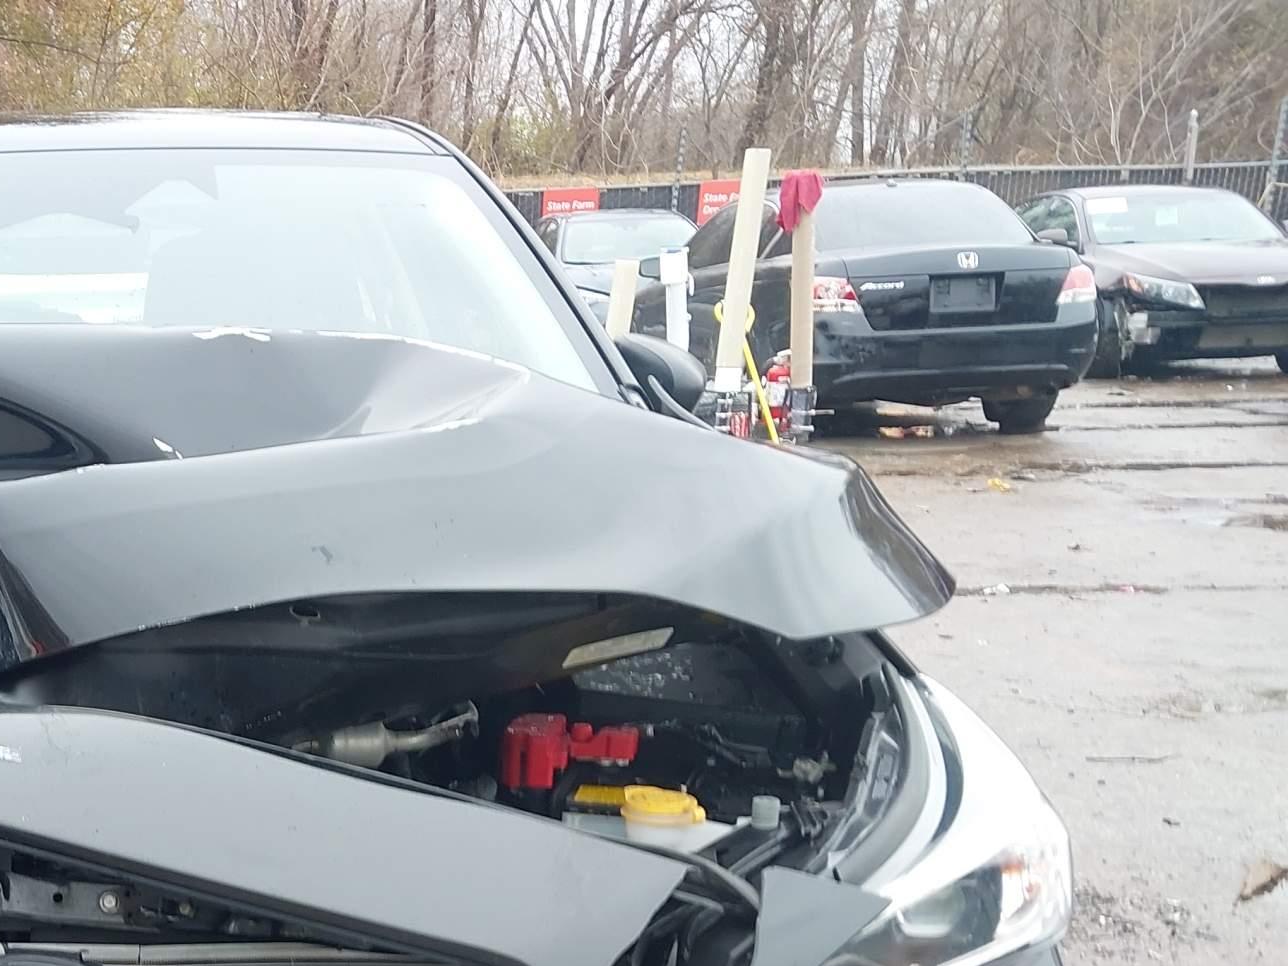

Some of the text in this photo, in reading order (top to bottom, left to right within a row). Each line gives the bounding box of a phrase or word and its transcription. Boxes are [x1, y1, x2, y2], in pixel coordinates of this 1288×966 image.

[704, 192, 728, 203] State
[546, 199, 595, 211] State Farm
[859, 281, 904, 291] Accord
